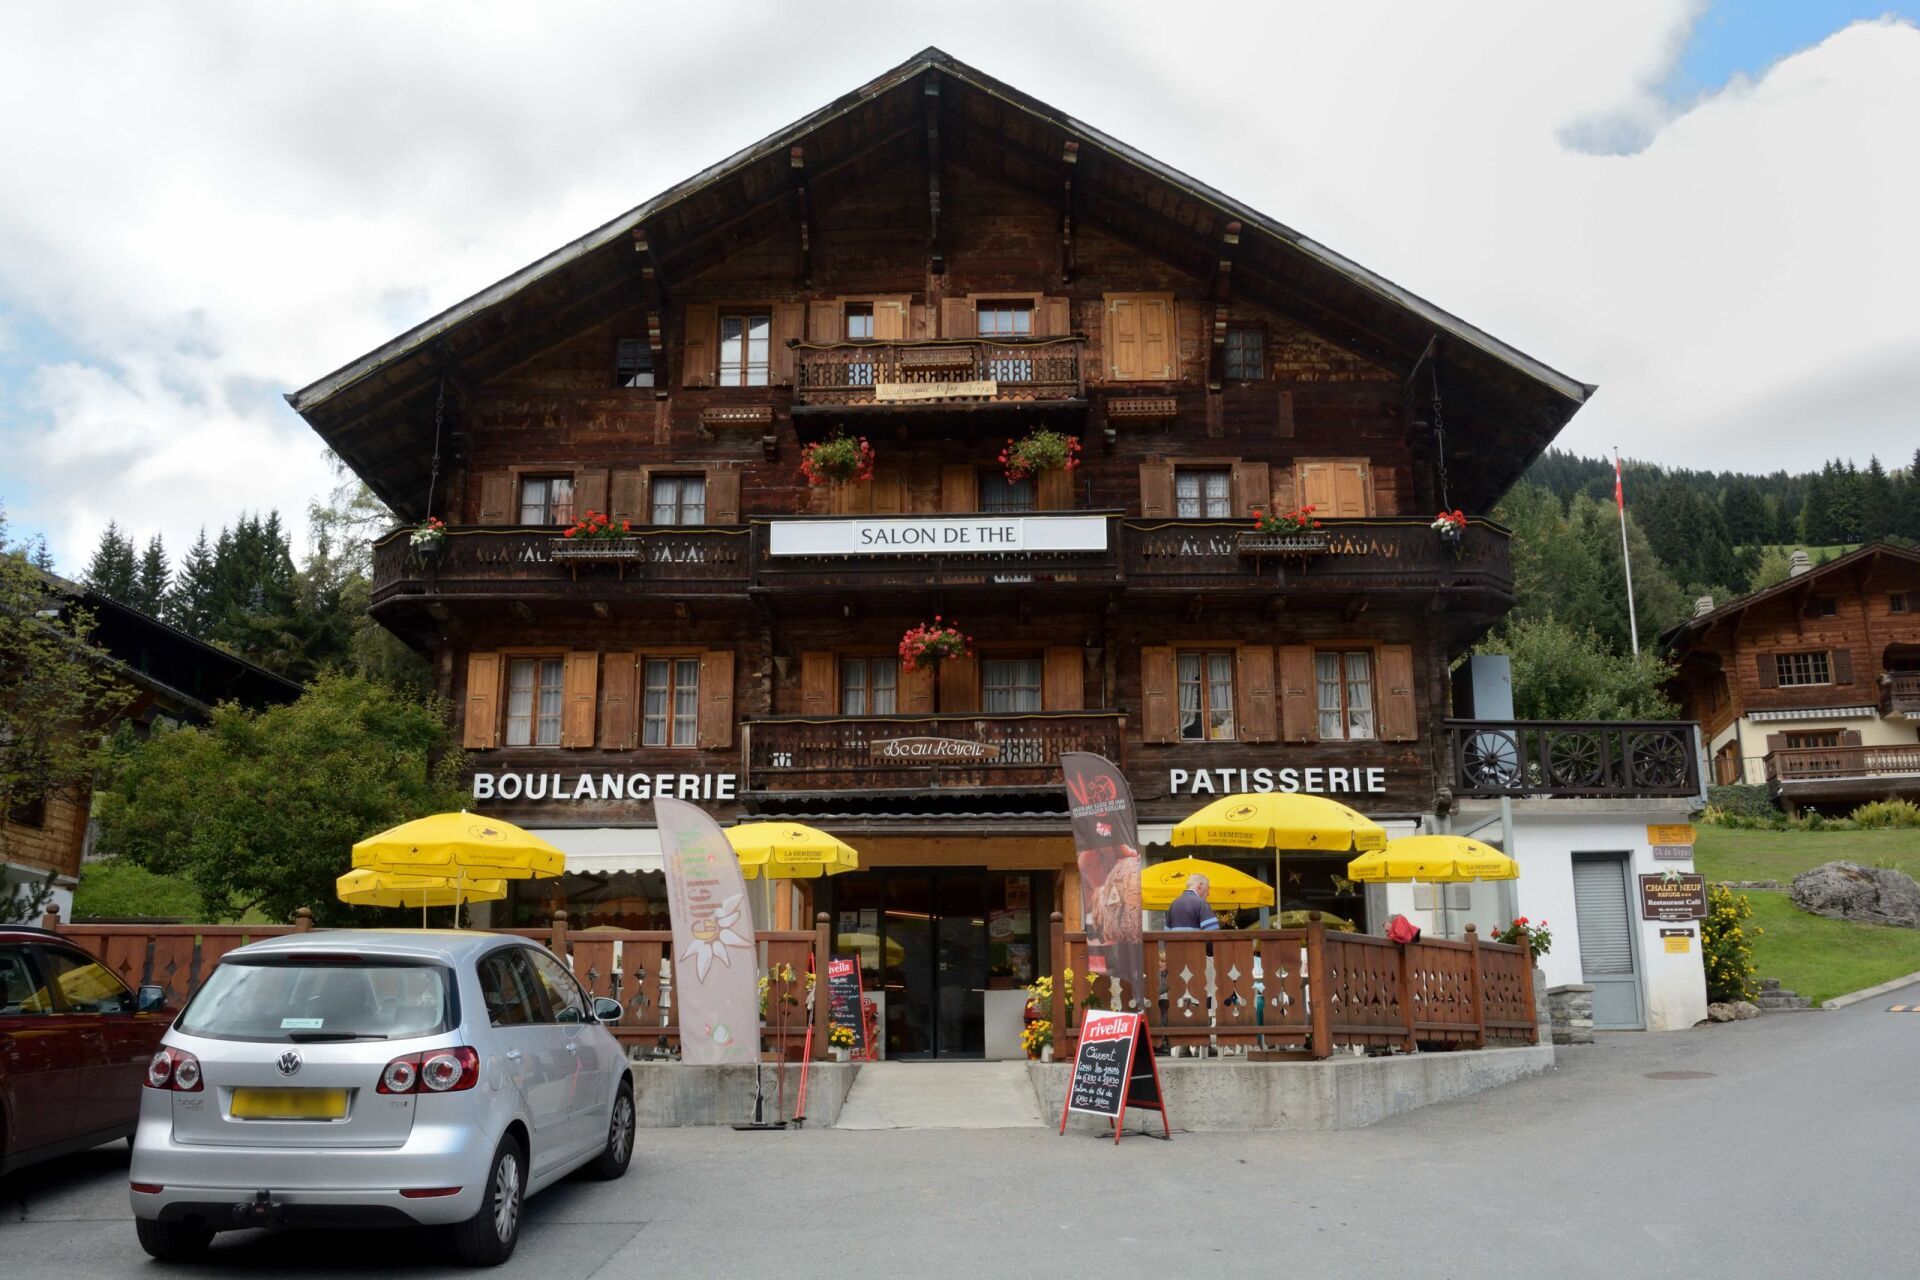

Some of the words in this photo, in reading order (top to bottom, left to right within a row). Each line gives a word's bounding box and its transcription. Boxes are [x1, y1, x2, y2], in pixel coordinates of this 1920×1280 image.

[861, 527, 936, 545] SALON
[943, 527, 971, 544] DE
[976, 526, 1017, 543] THE
[883, 740, 933, 757] Beau
[473, 773, 737, 800] BOULANGERIE
[1170, 767, 1386, 794] PATISSERIE
[1645, 884, 1678, 892] CHALET
[1679, 883, 1702, 891] NEUF
[828, 962, 850, 974] ivella
[1089, 1019, 1128, 1037] rivella
